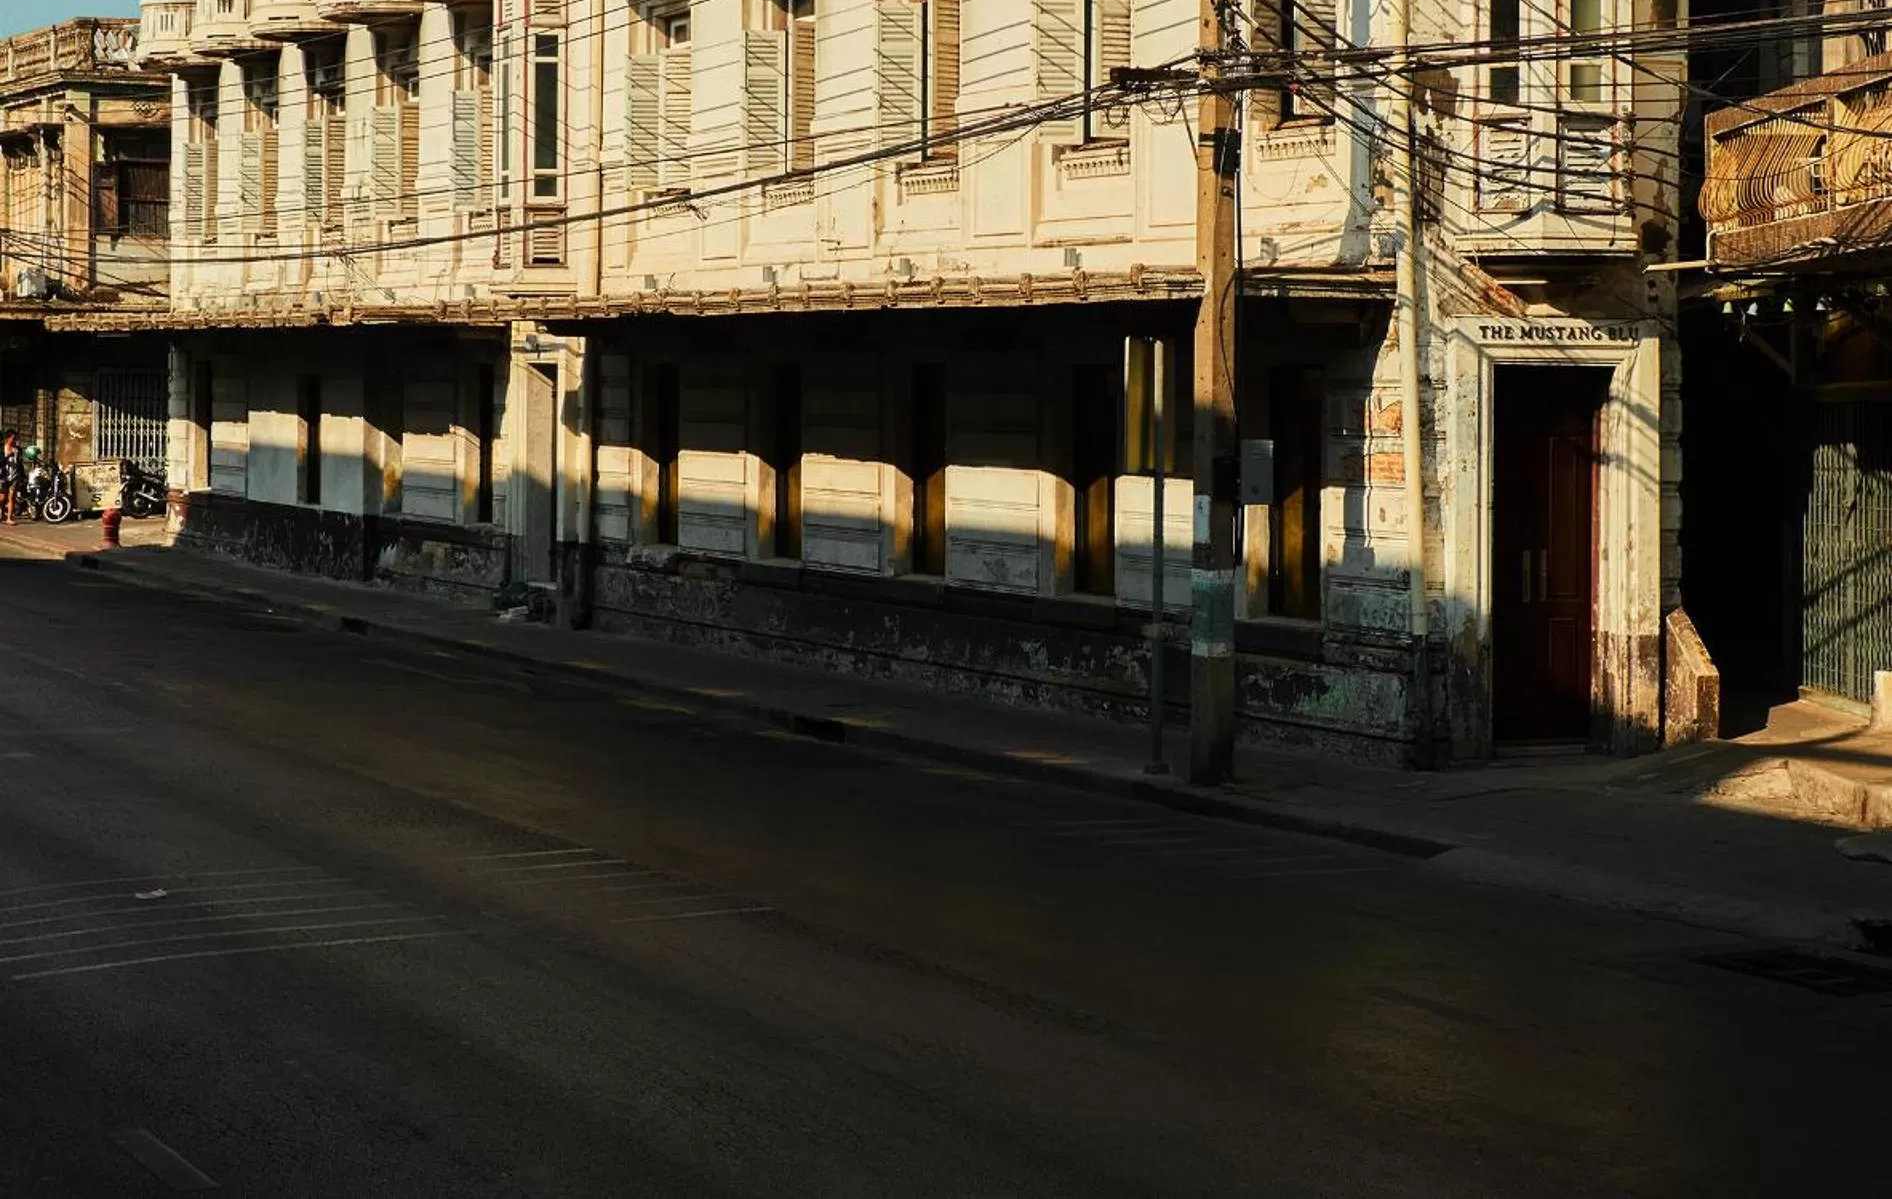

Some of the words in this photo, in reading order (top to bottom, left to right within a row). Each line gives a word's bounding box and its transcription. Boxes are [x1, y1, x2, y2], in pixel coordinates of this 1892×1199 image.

[1479, 325, 1515, 341] THE
[1519, 326, 1603, 341] MUSTANG
[1608, 327, 1639, 342] BLU
